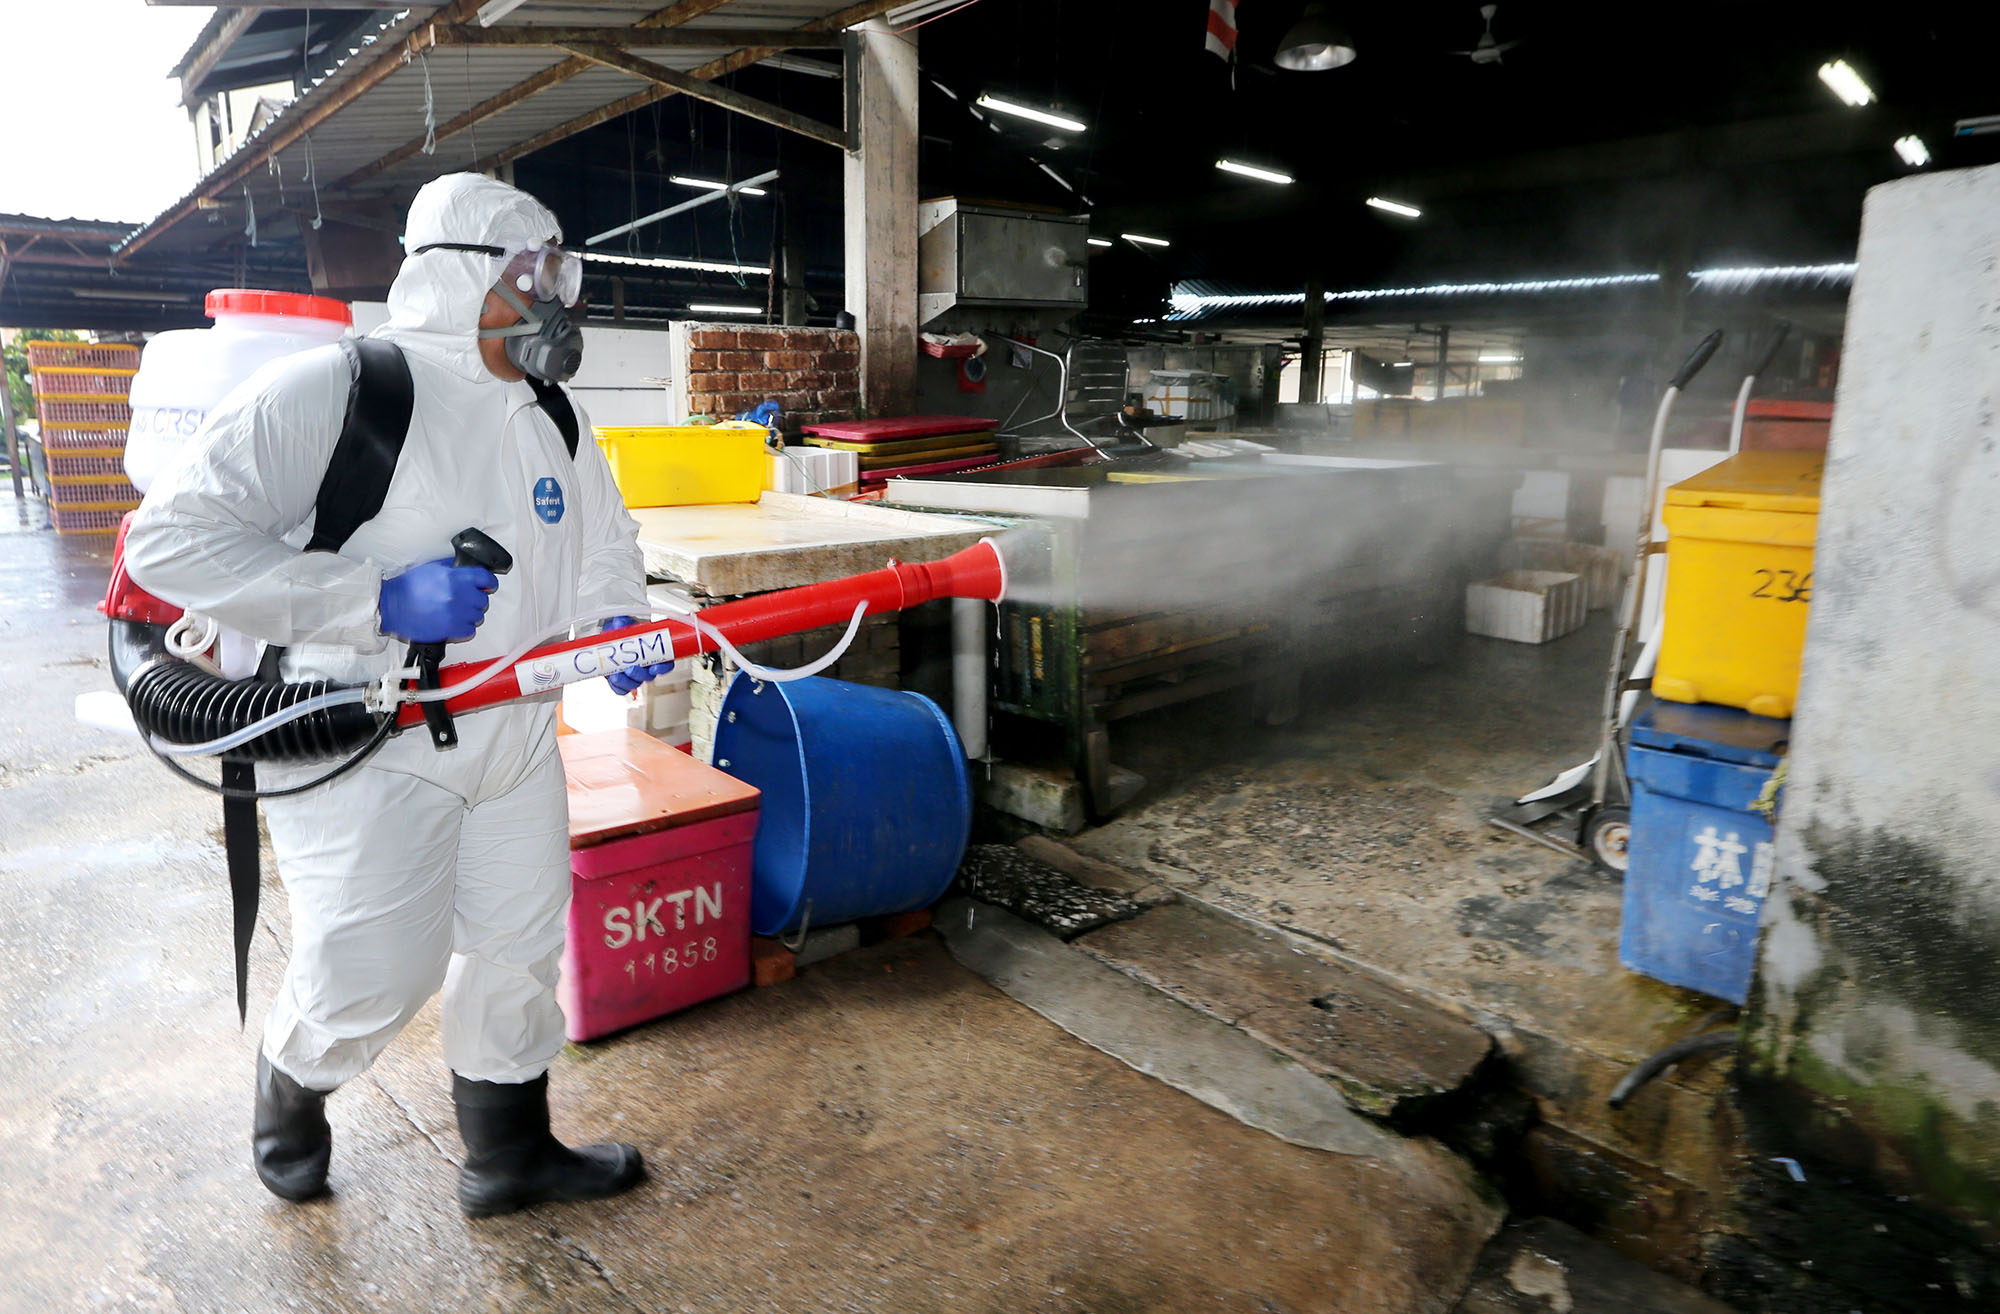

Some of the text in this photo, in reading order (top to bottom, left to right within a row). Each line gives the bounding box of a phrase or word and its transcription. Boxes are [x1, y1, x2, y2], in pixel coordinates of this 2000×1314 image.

[573, 633, 666, 675] CRSM
[603, 881, 723, 950] SKTN
[624, 936, 718, 984] 11858
